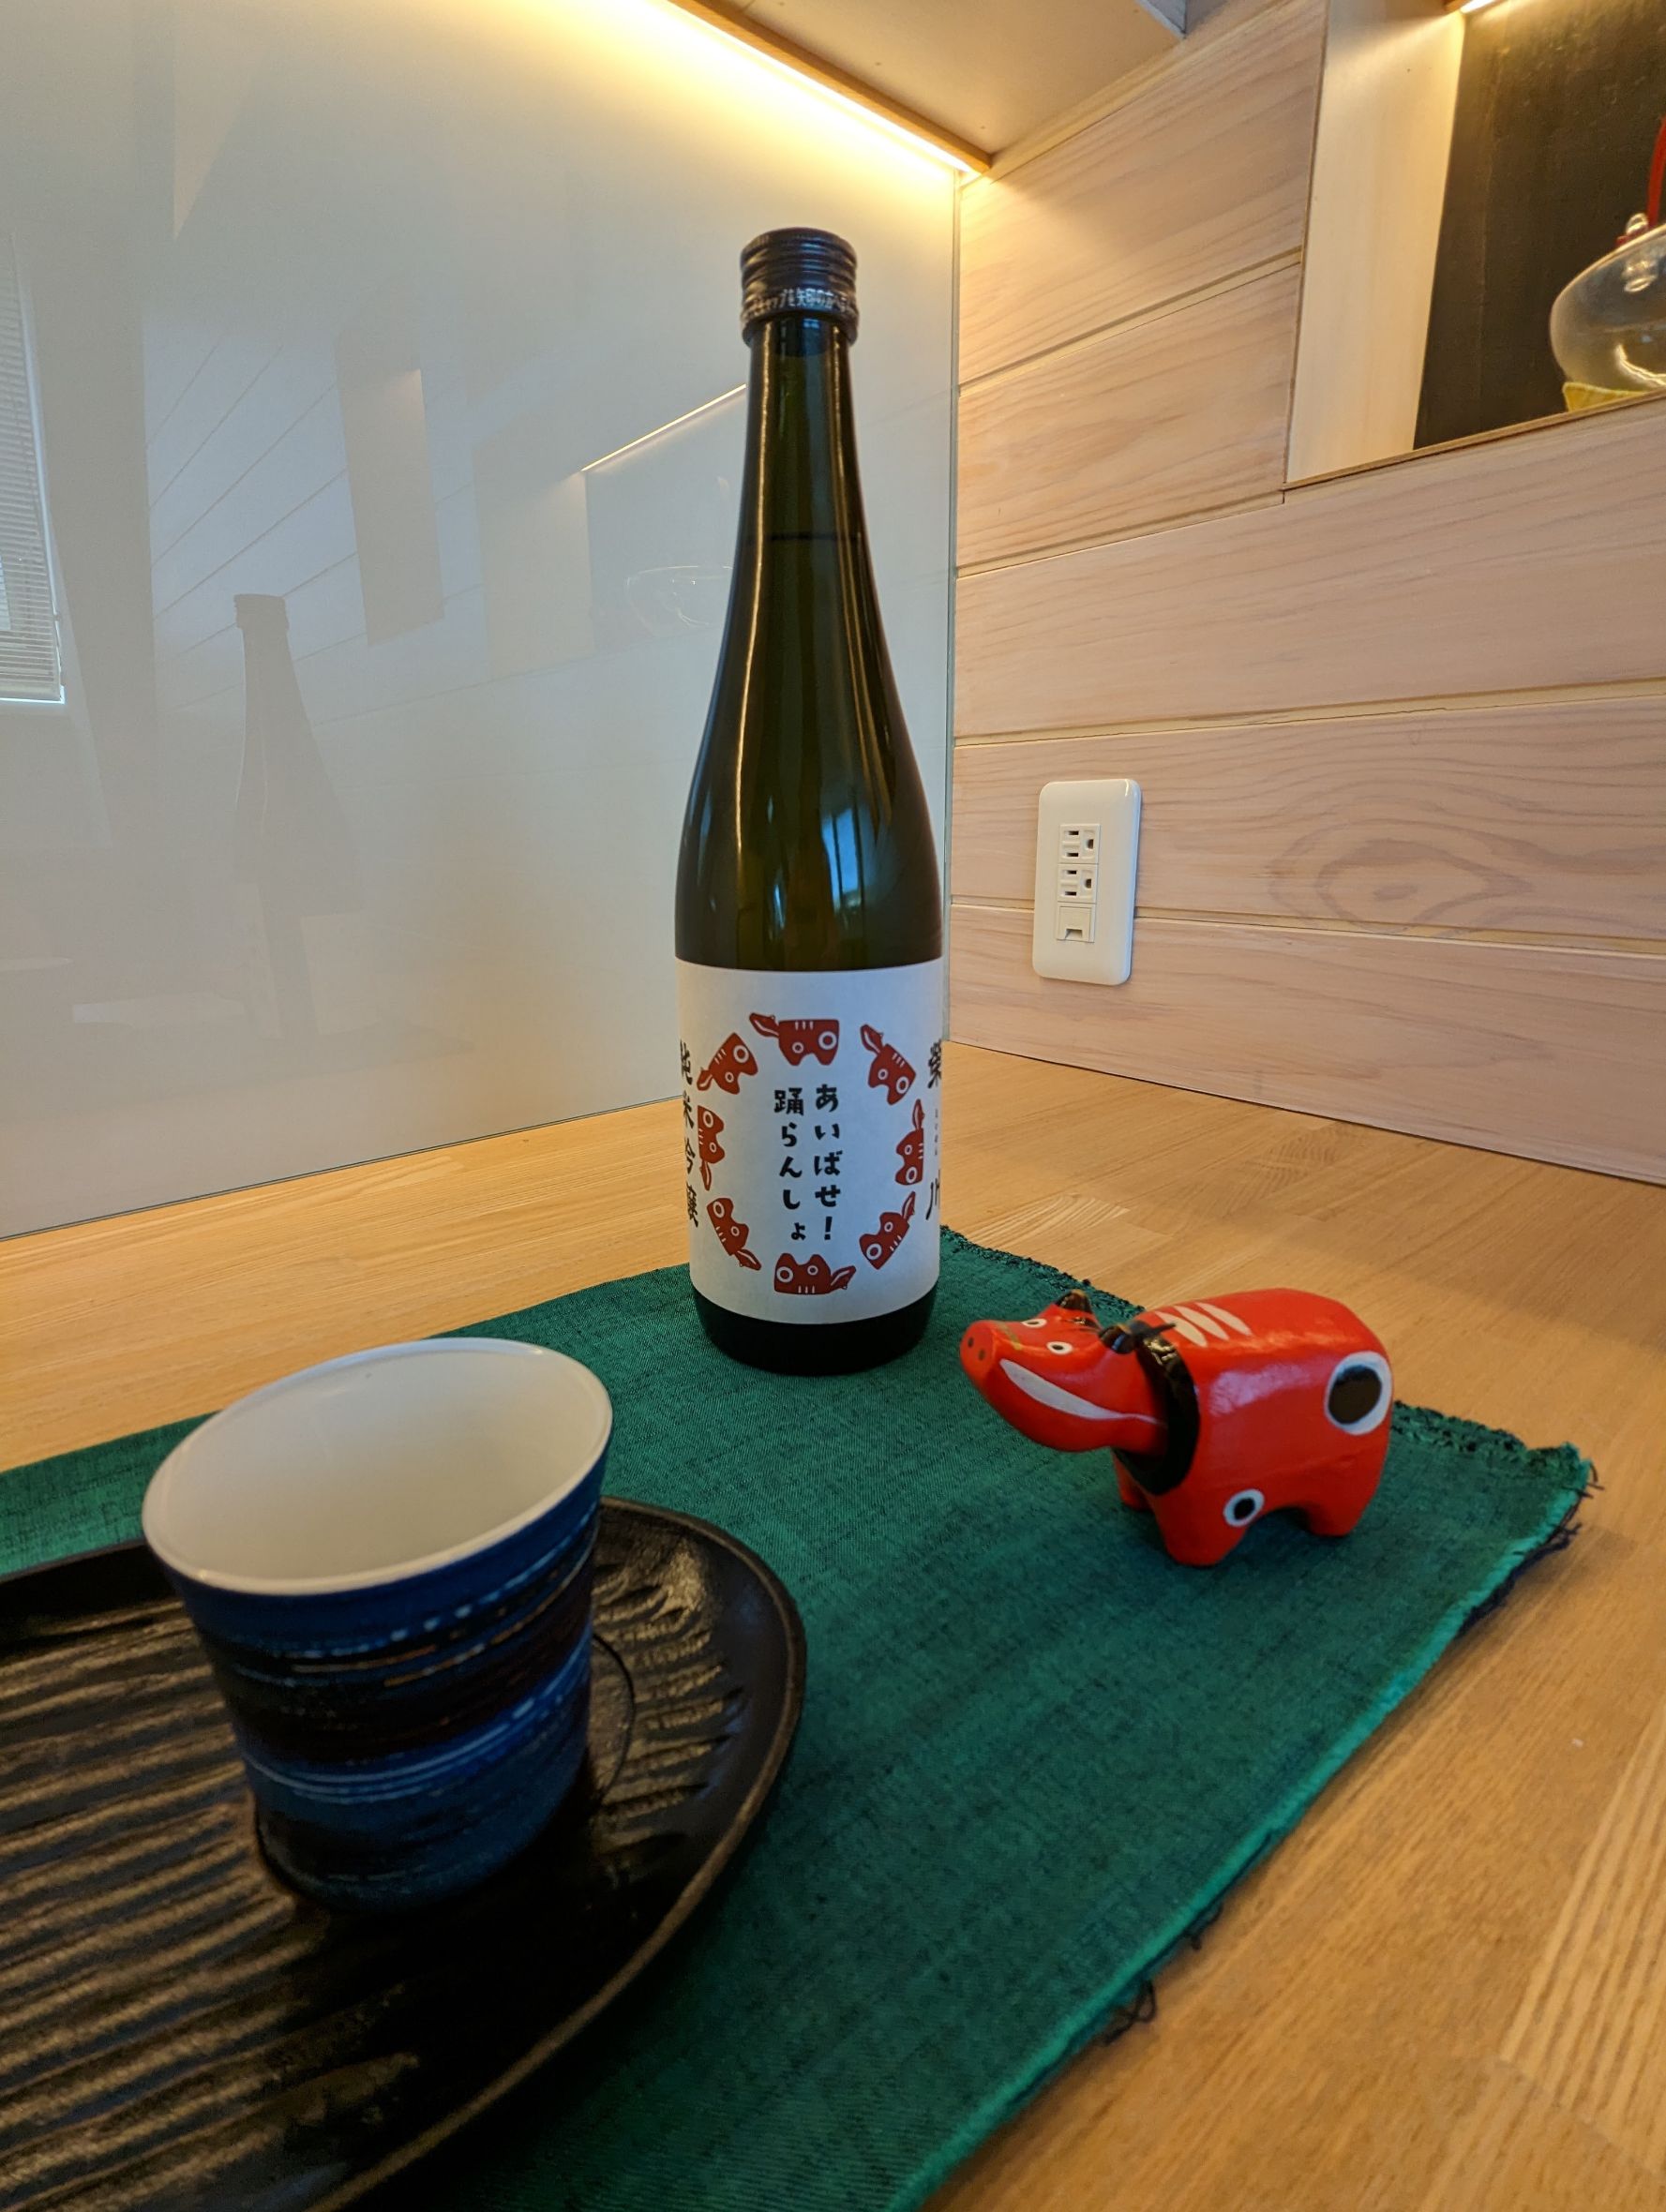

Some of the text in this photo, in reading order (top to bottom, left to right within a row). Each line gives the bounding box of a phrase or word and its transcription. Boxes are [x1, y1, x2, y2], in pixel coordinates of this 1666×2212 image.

[773, 1087, 805, 1241] 踊らんしょ
